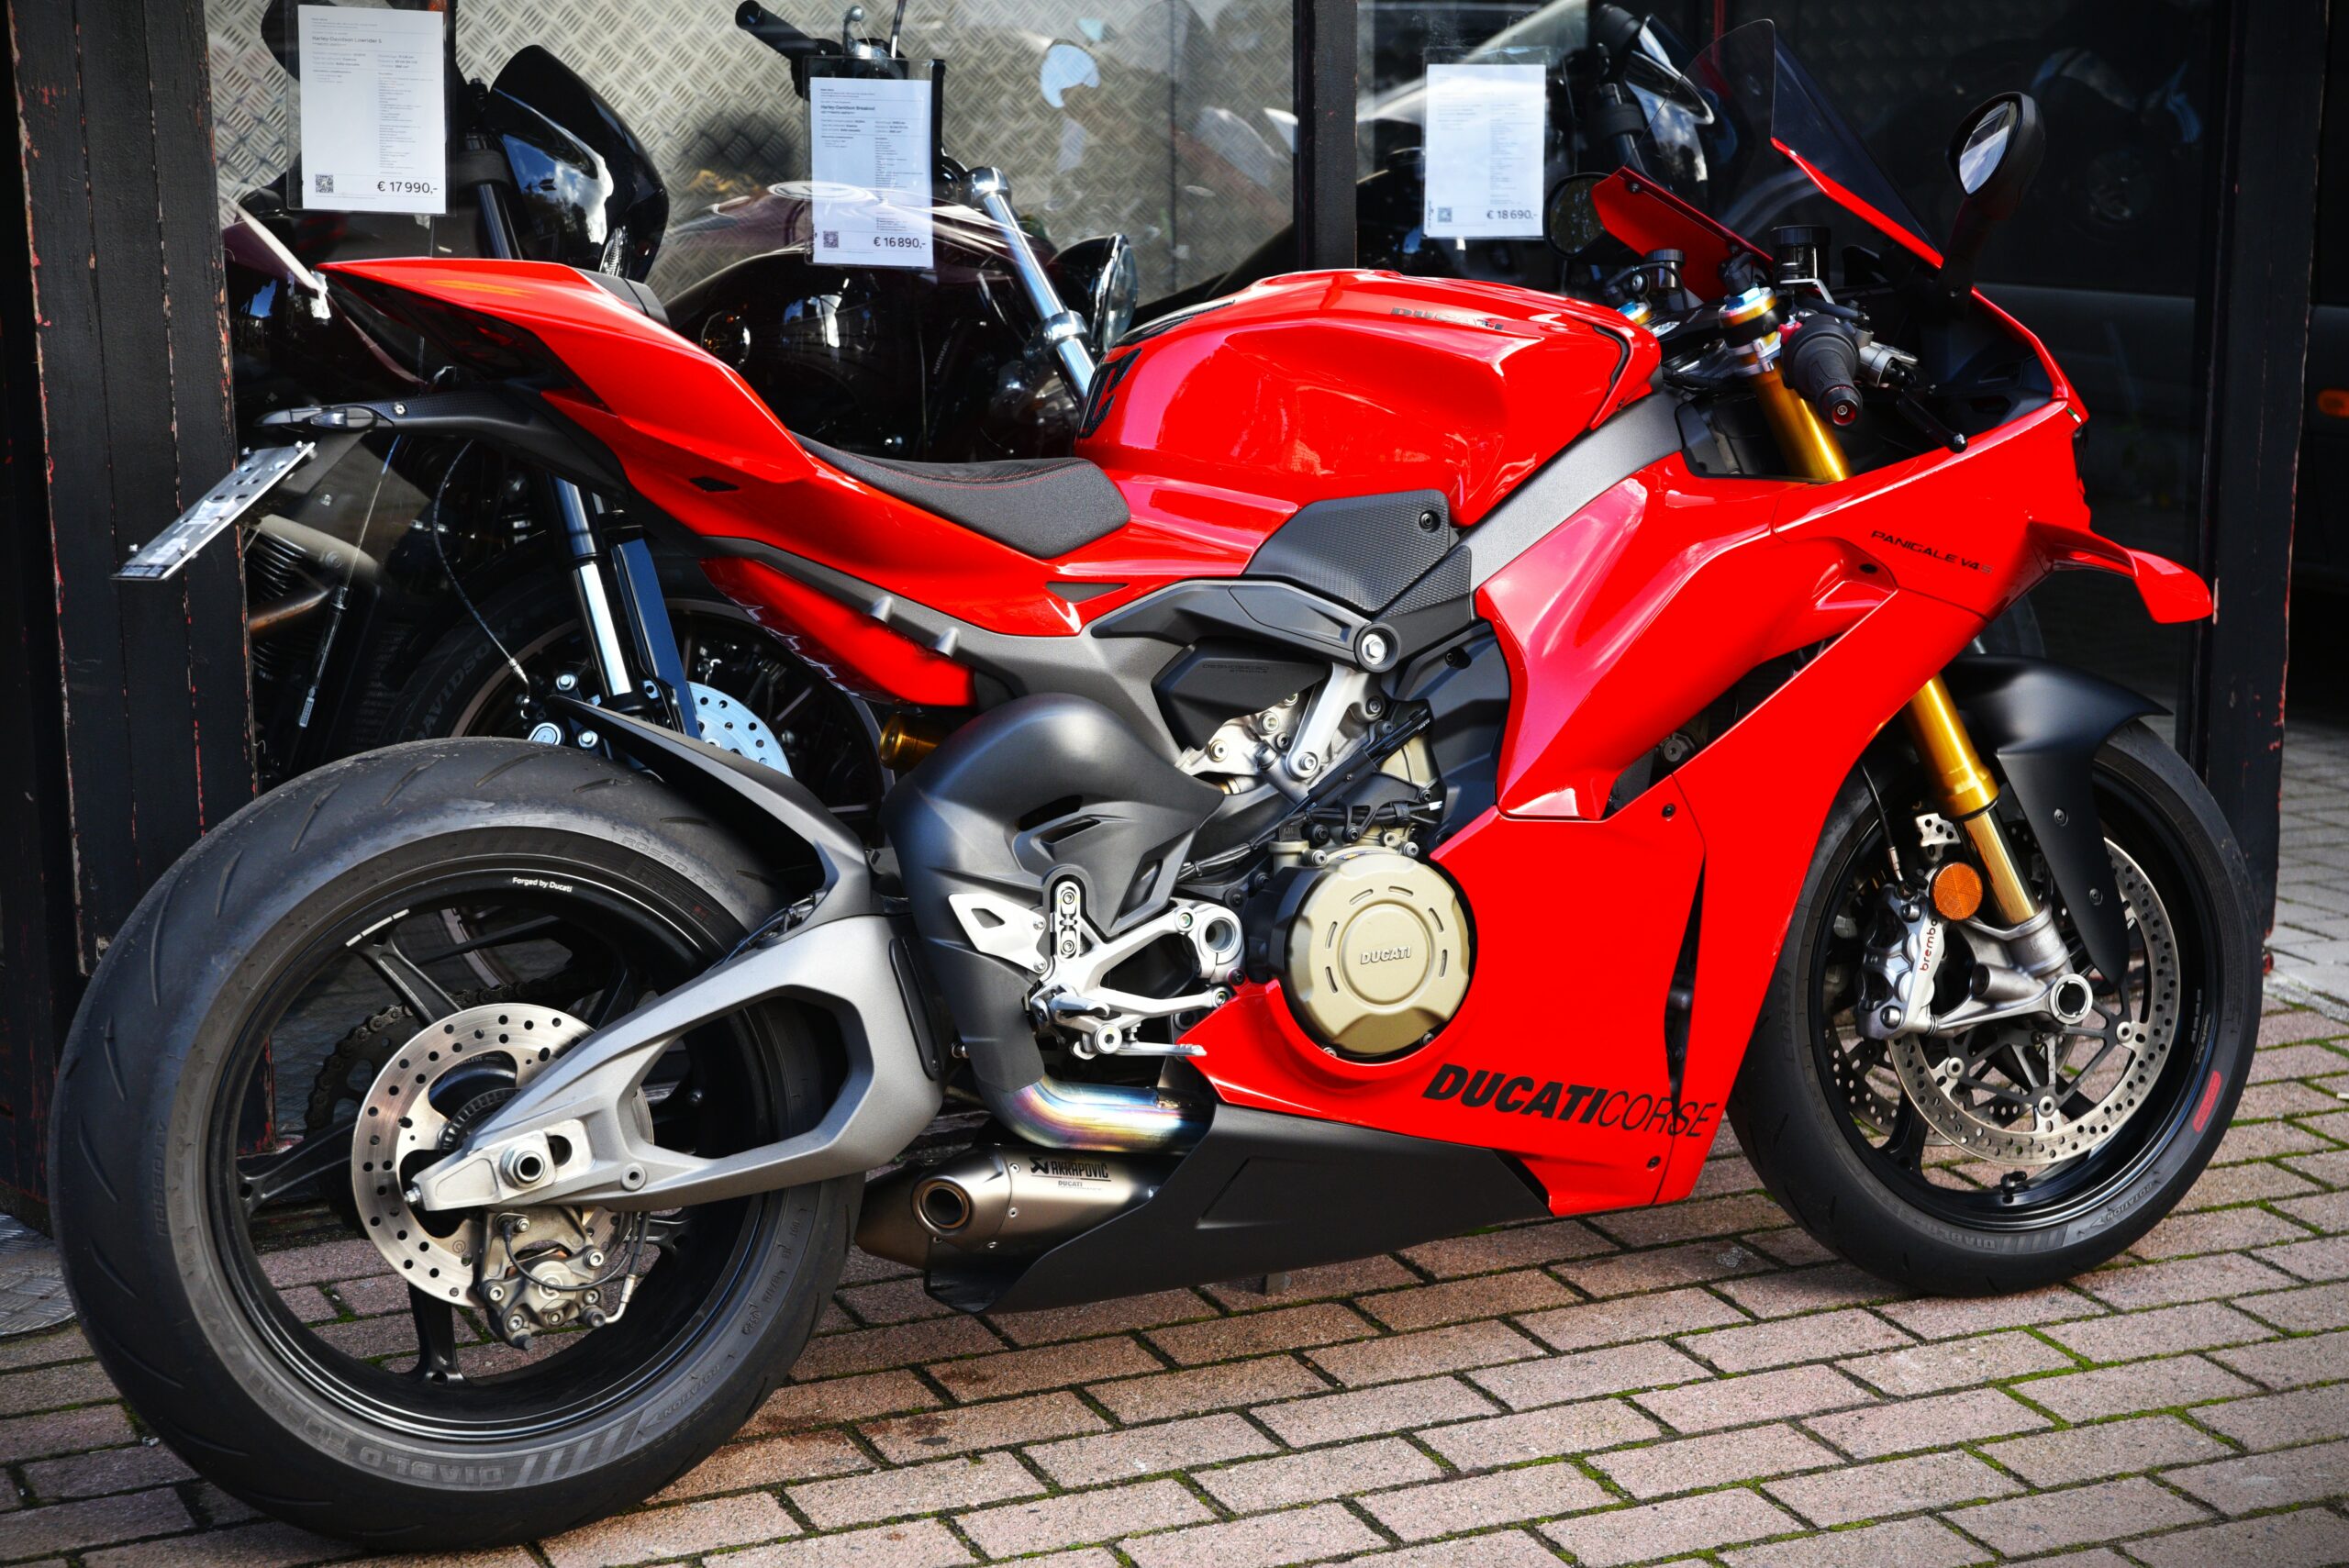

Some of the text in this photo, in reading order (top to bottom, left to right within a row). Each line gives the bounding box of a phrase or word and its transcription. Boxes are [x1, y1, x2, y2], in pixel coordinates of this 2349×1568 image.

[377, 181, 385, 192] €
[874, 237, 881, 247] €
[1871, 530, 1958, 563] PANIGALE
[620, 835, 688, 873] ROSSO
[512, 876, 573, 893] Forged by Ducati
[1360, 946, 1411, 965] DUCATI
[1920, 918, 1938, 972] brembo
[662, 1363, 721, 1417] ROTATION
[360, 1446, 504, 1486] DIABLO
